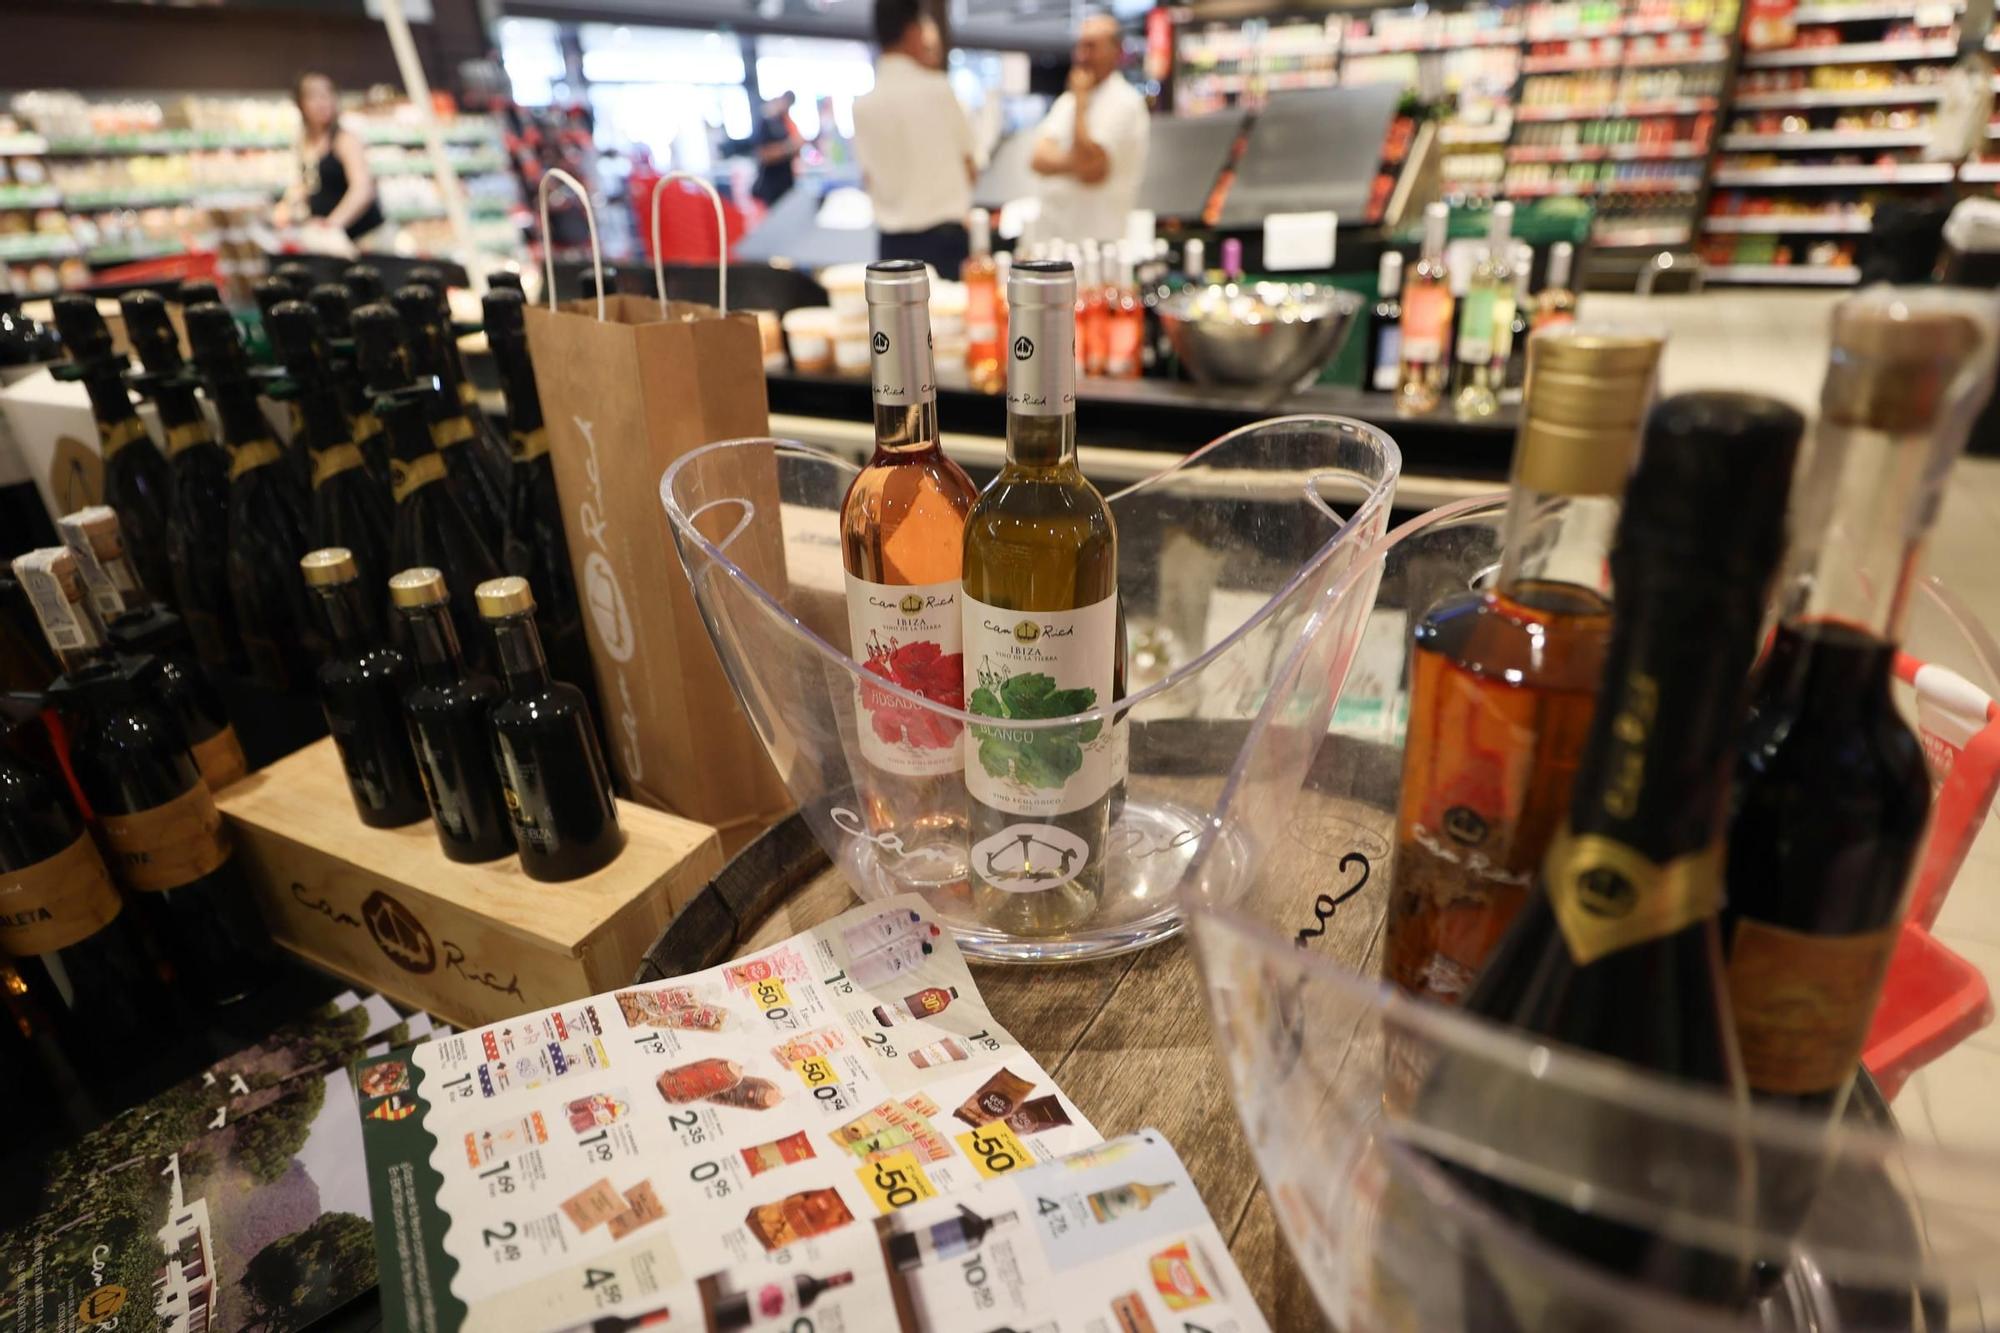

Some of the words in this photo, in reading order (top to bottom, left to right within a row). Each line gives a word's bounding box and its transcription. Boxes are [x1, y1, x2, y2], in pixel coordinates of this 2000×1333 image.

[869, 596, 897, 609] Can
[925, 593, 954, 608] Rich
[897, 618, 926, 626] IBIZA
[983, 620, 1011, 634] Can
[1042, 625, 1074, 639] Rich
[995, 650, 1011, 659] VINO
[1010, 645, 1041, 656] IBIZA
[290, 882, 361, 927] Can
[441, 939, 526, 1004] Rich
[91, 1244, 109, 1287] Can
